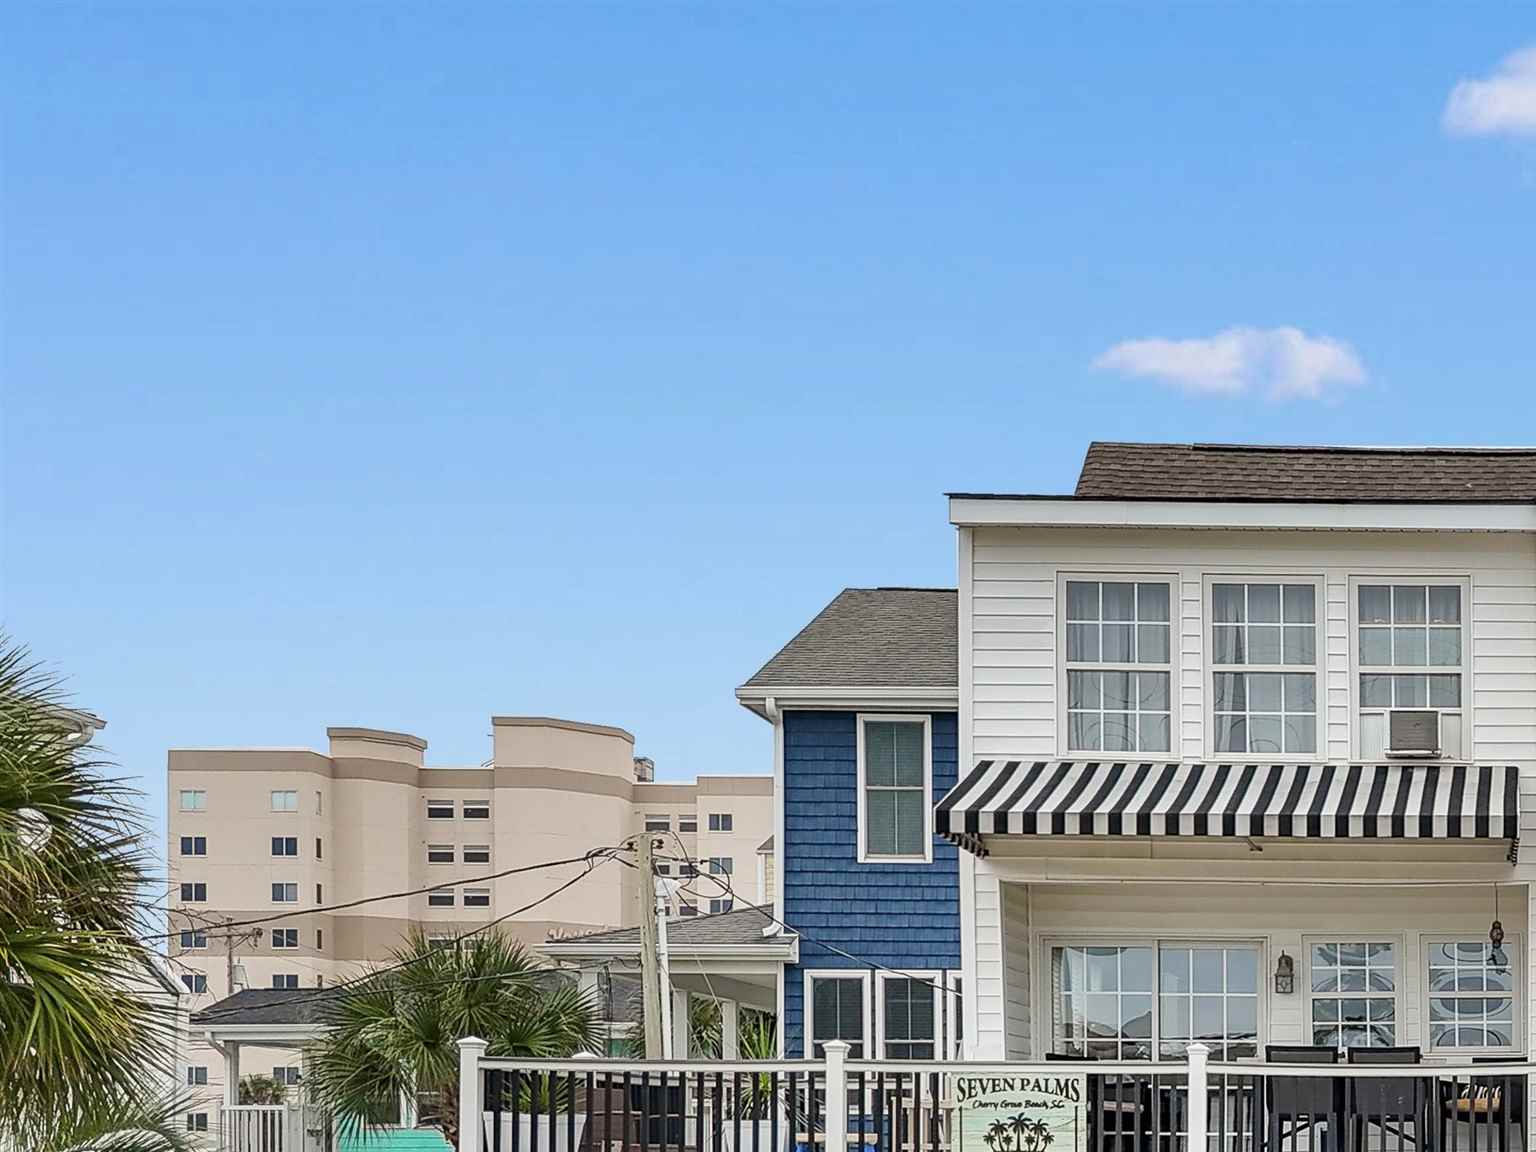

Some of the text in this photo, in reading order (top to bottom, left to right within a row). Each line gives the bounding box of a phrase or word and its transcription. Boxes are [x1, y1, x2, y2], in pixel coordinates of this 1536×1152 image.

[957, 1077, 1080, 1102] SEVEN PALMS
[972, 1099, 999, 1111] Cherry
[1000, 1099, 1022, 1109] Grove
